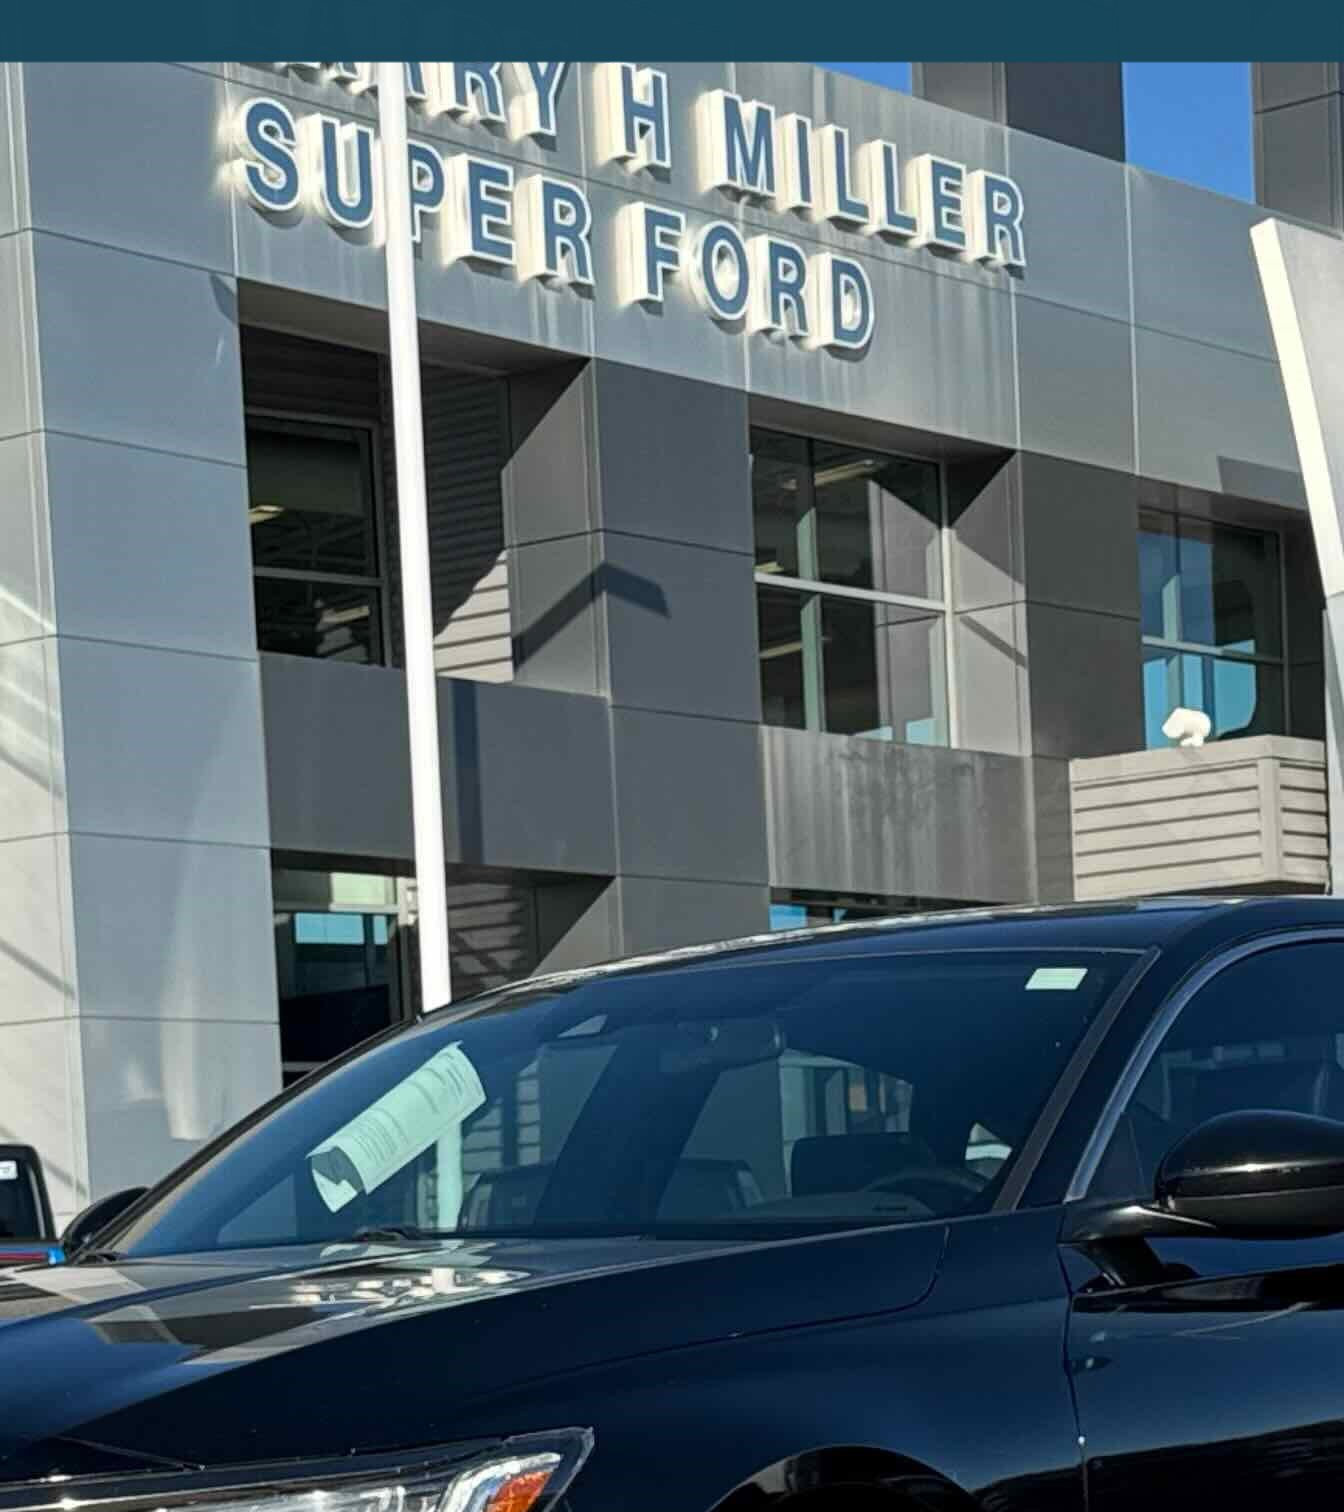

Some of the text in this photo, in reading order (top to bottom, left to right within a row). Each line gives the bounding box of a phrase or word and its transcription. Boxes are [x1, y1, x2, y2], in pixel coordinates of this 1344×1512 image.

[243, 96, 596, 285] SUPER
[631, 200, 875, 349] FORD
[611, 62, 671, 168] H
[708, 90, 1026, 267] MILLER
